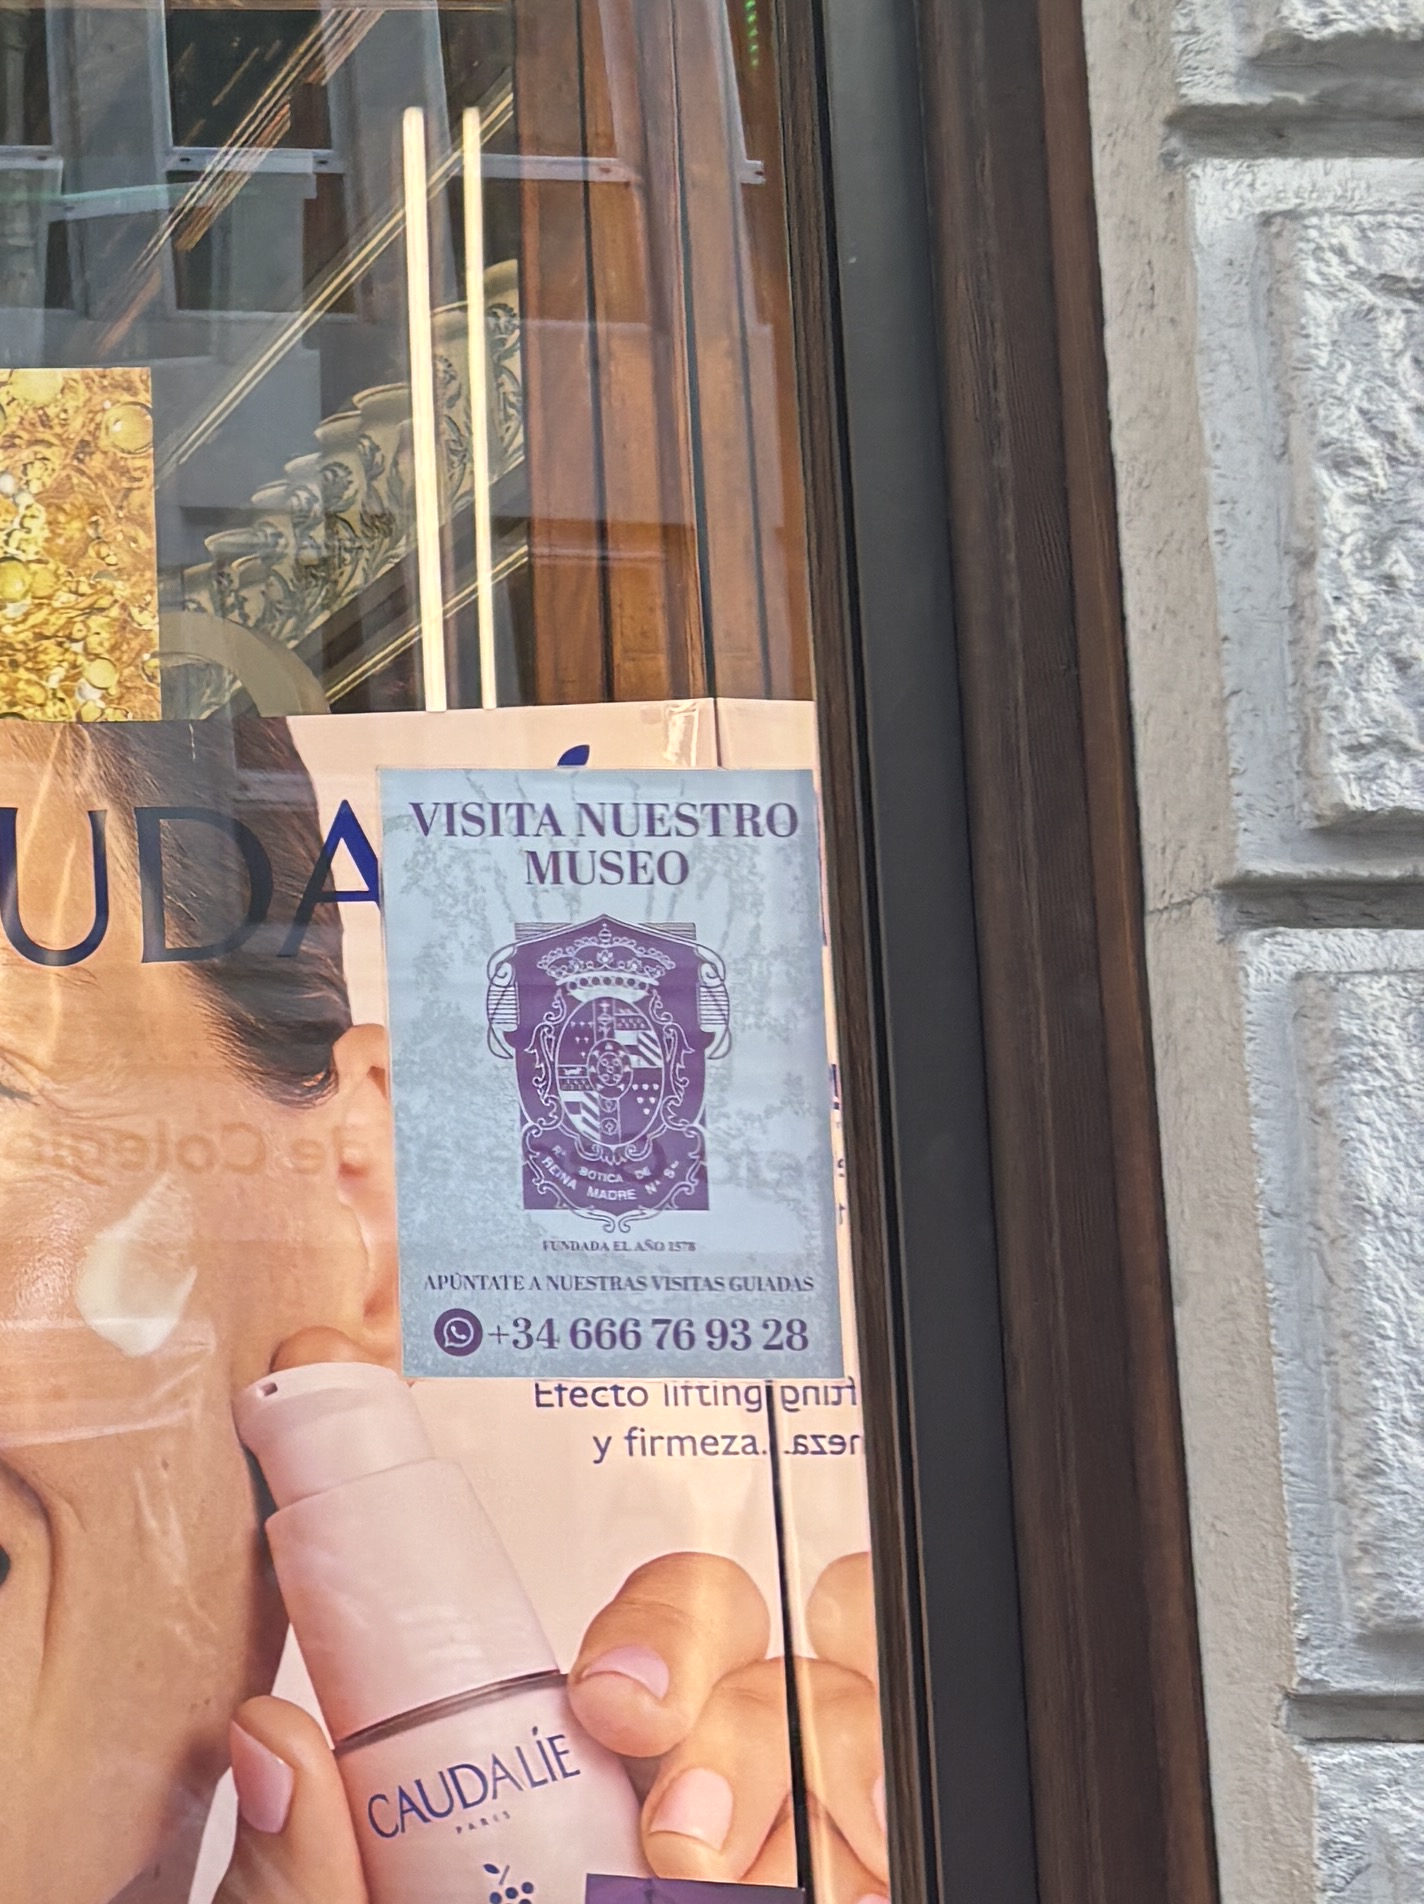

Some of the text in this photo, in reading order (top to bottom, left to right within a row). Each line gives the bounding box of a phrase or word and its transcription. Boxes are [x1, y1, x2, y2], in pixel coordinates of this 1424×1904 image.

[408, 801, 798, 839] VISITA NUESTRO
[524, 848, 689, 887] MUSEO
[541, 1156, 638, 1201] REINA MADRE
[579, 1165, 624, 1183] BOTICA
[542, 1239, 610, 1252] FUNDADA
[613, 1240, 632, 1252] EL
[633, 1238, 665, 1252] AÑO
[424, 1268, 815, 1293] APÚNTATE A NUESTRAS VISITAS GUIADAS
[488, 1316, 810, 1352] +34 666 76 93 28
[594, 1428, 768, 1464] y firmeza.
